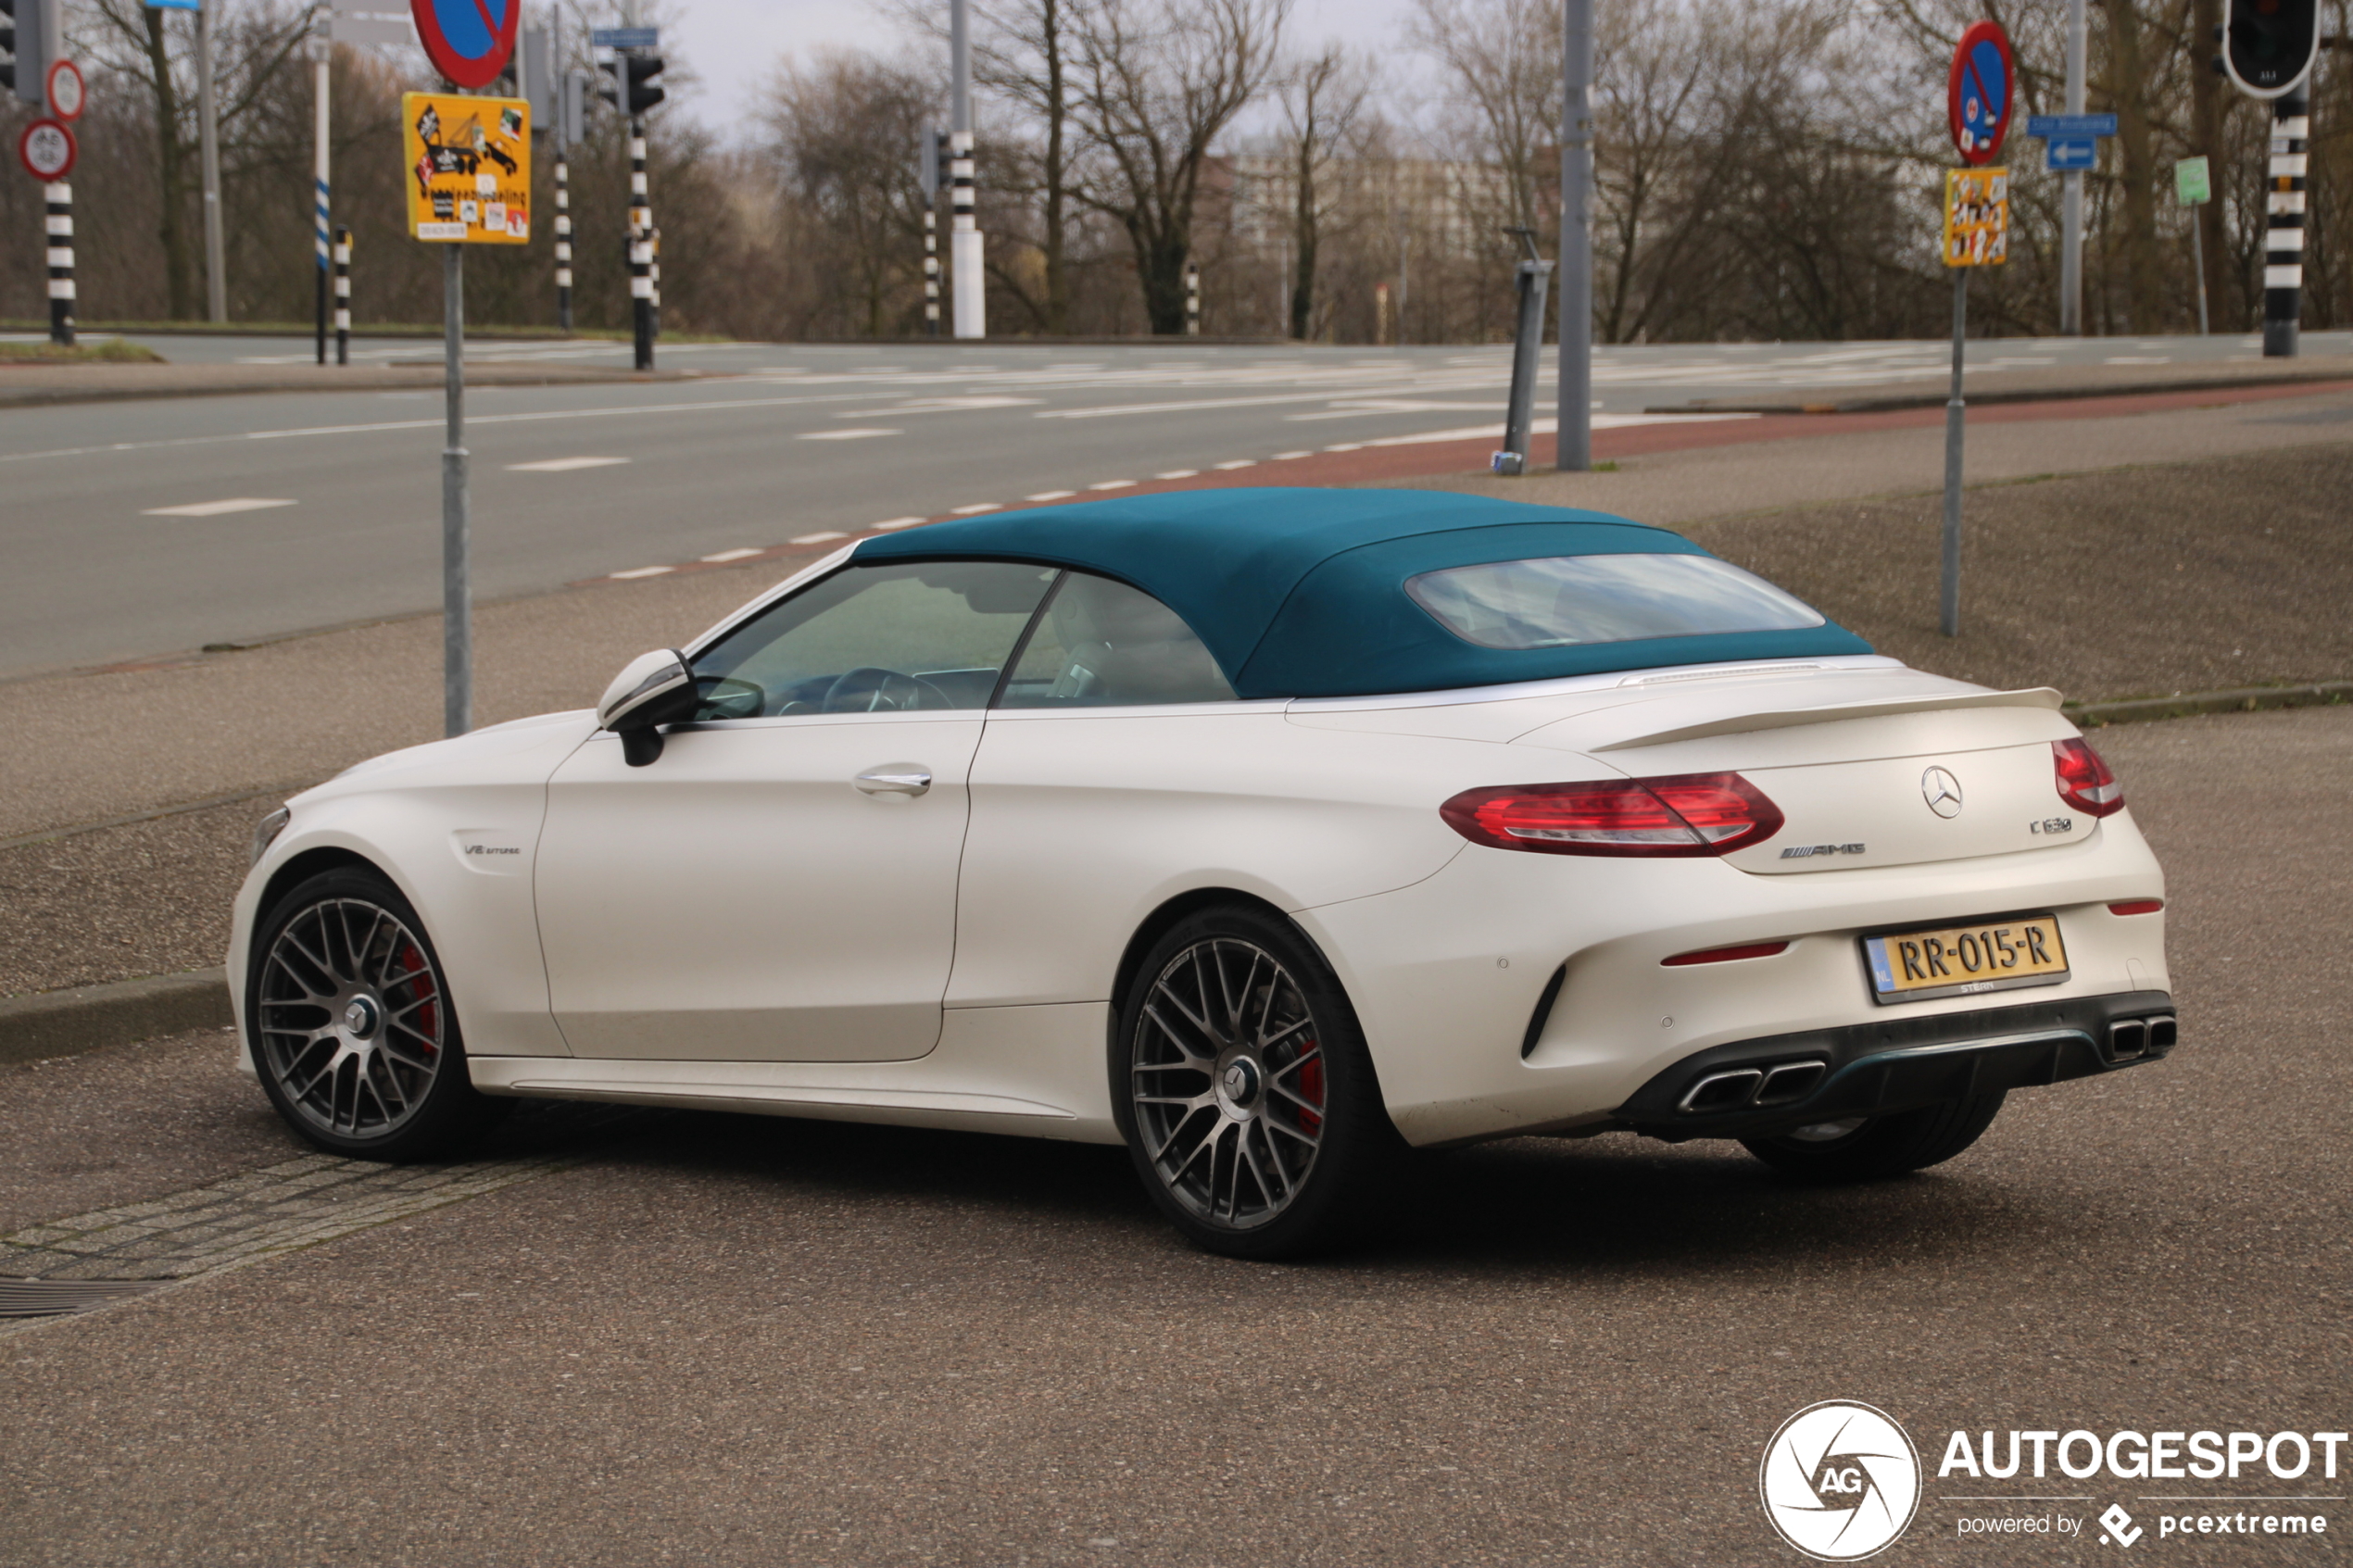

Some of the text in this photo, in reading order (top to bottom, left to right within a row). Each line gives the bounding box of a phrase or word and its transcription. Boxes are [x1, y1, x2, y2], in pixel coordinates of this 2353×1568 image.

[465, 845, 484, 854] V8
[1899, 926, 2052, 980] RR-015-R
[1876, 971, 1891, 983] NL
[1960, 981, 1994, 993] STERN
